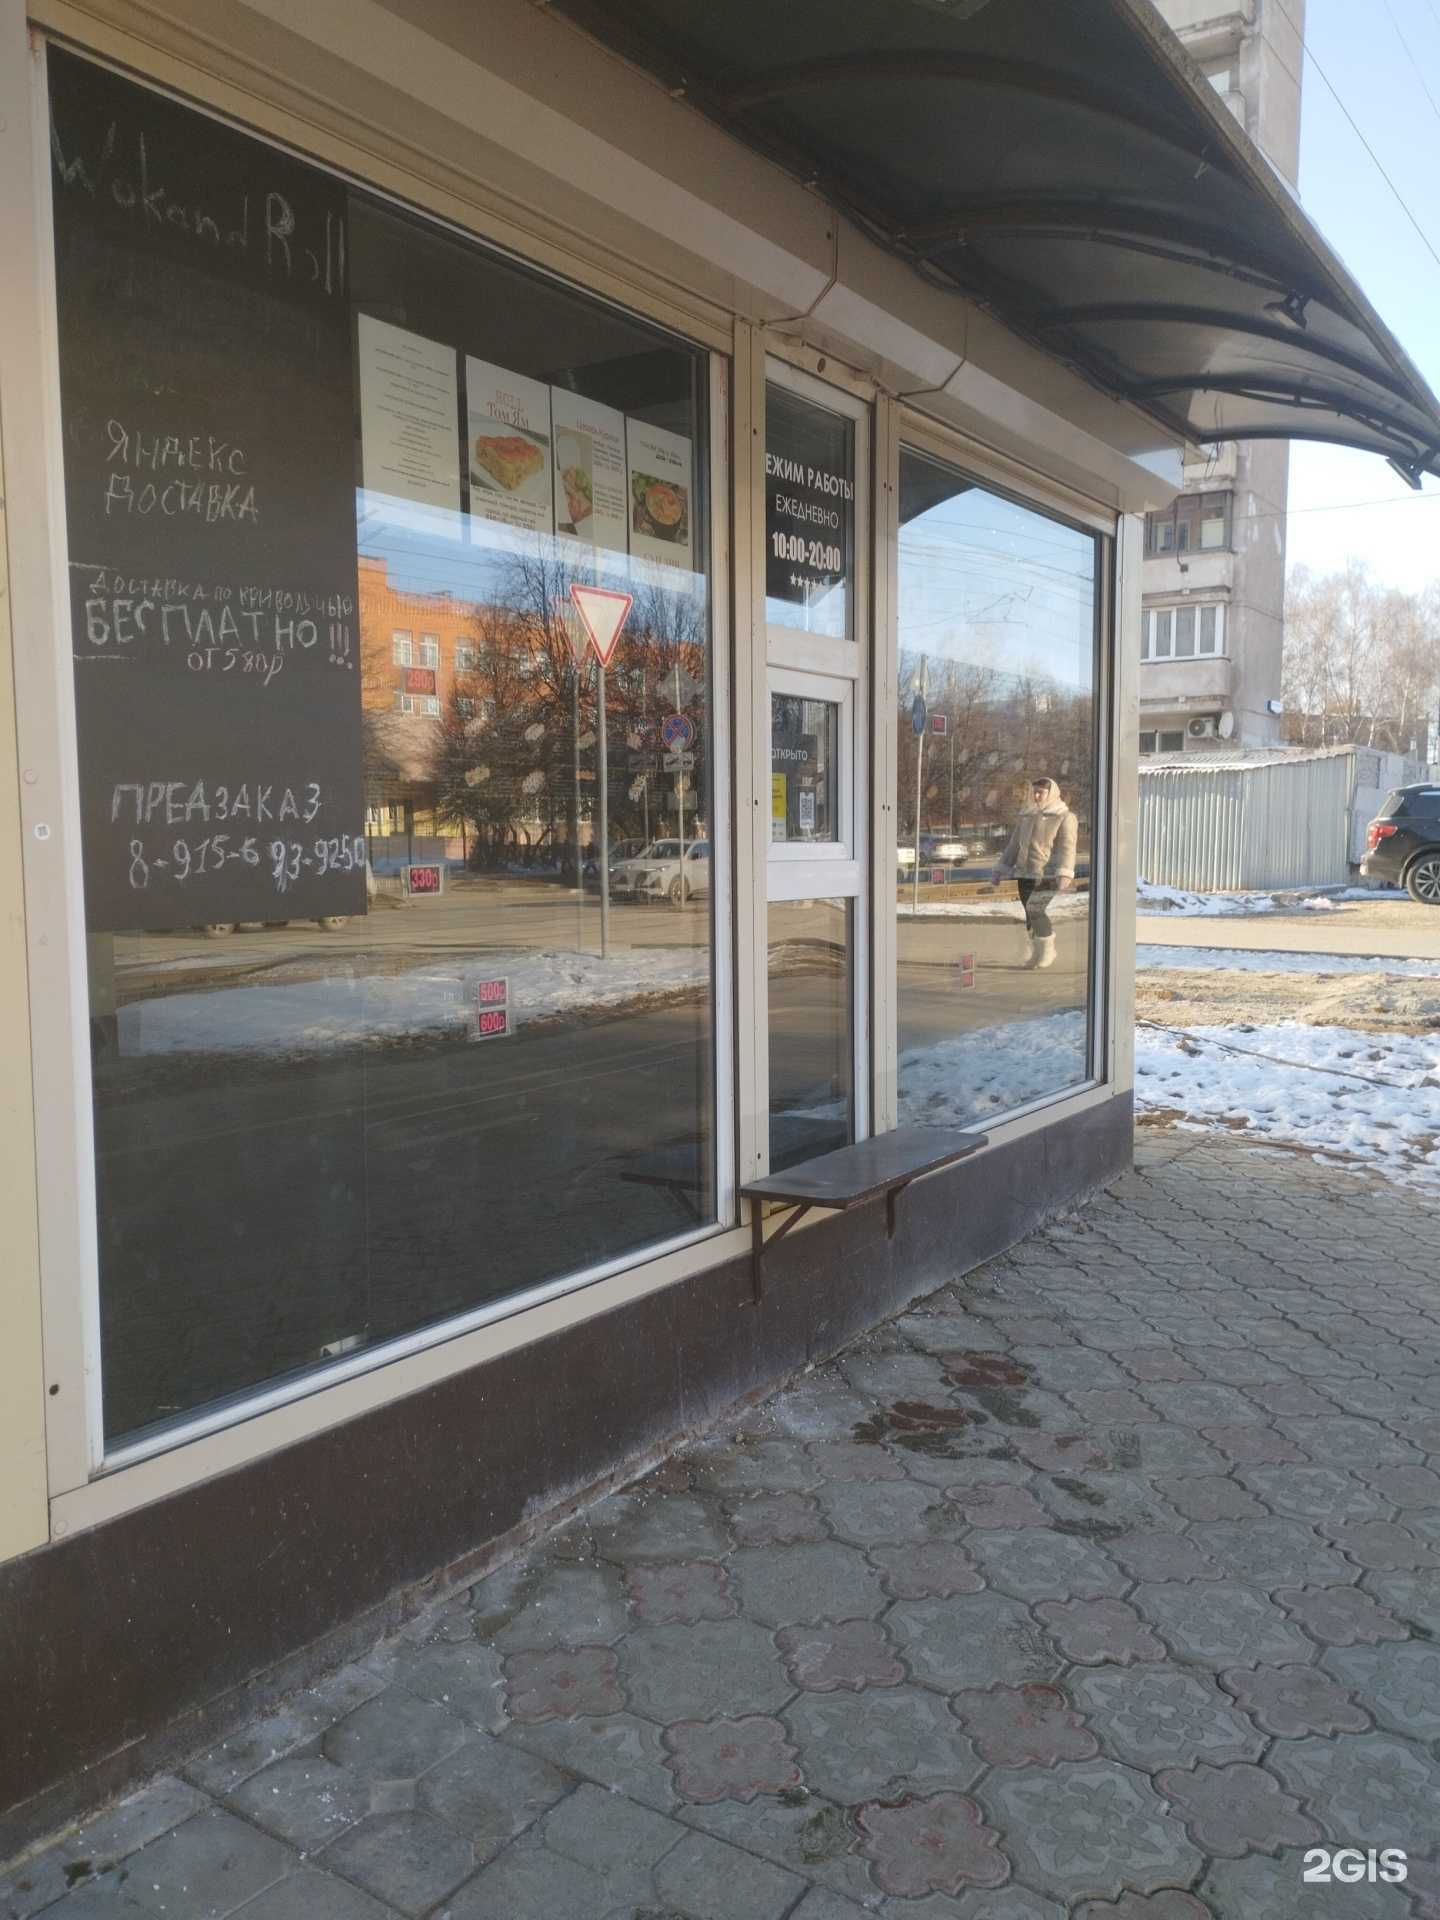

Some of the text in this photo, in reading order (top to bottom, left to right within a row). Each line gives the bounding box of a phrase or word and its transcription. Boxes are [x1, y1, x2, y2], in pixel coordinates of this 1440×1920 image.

[765, 452, 854, 501] ЕЖИМ РАБОТЫ
[775, 494, 839, 529] ЕЖЕДНЕВНО
[772, 531, 841, 572] 10:00-20:00
